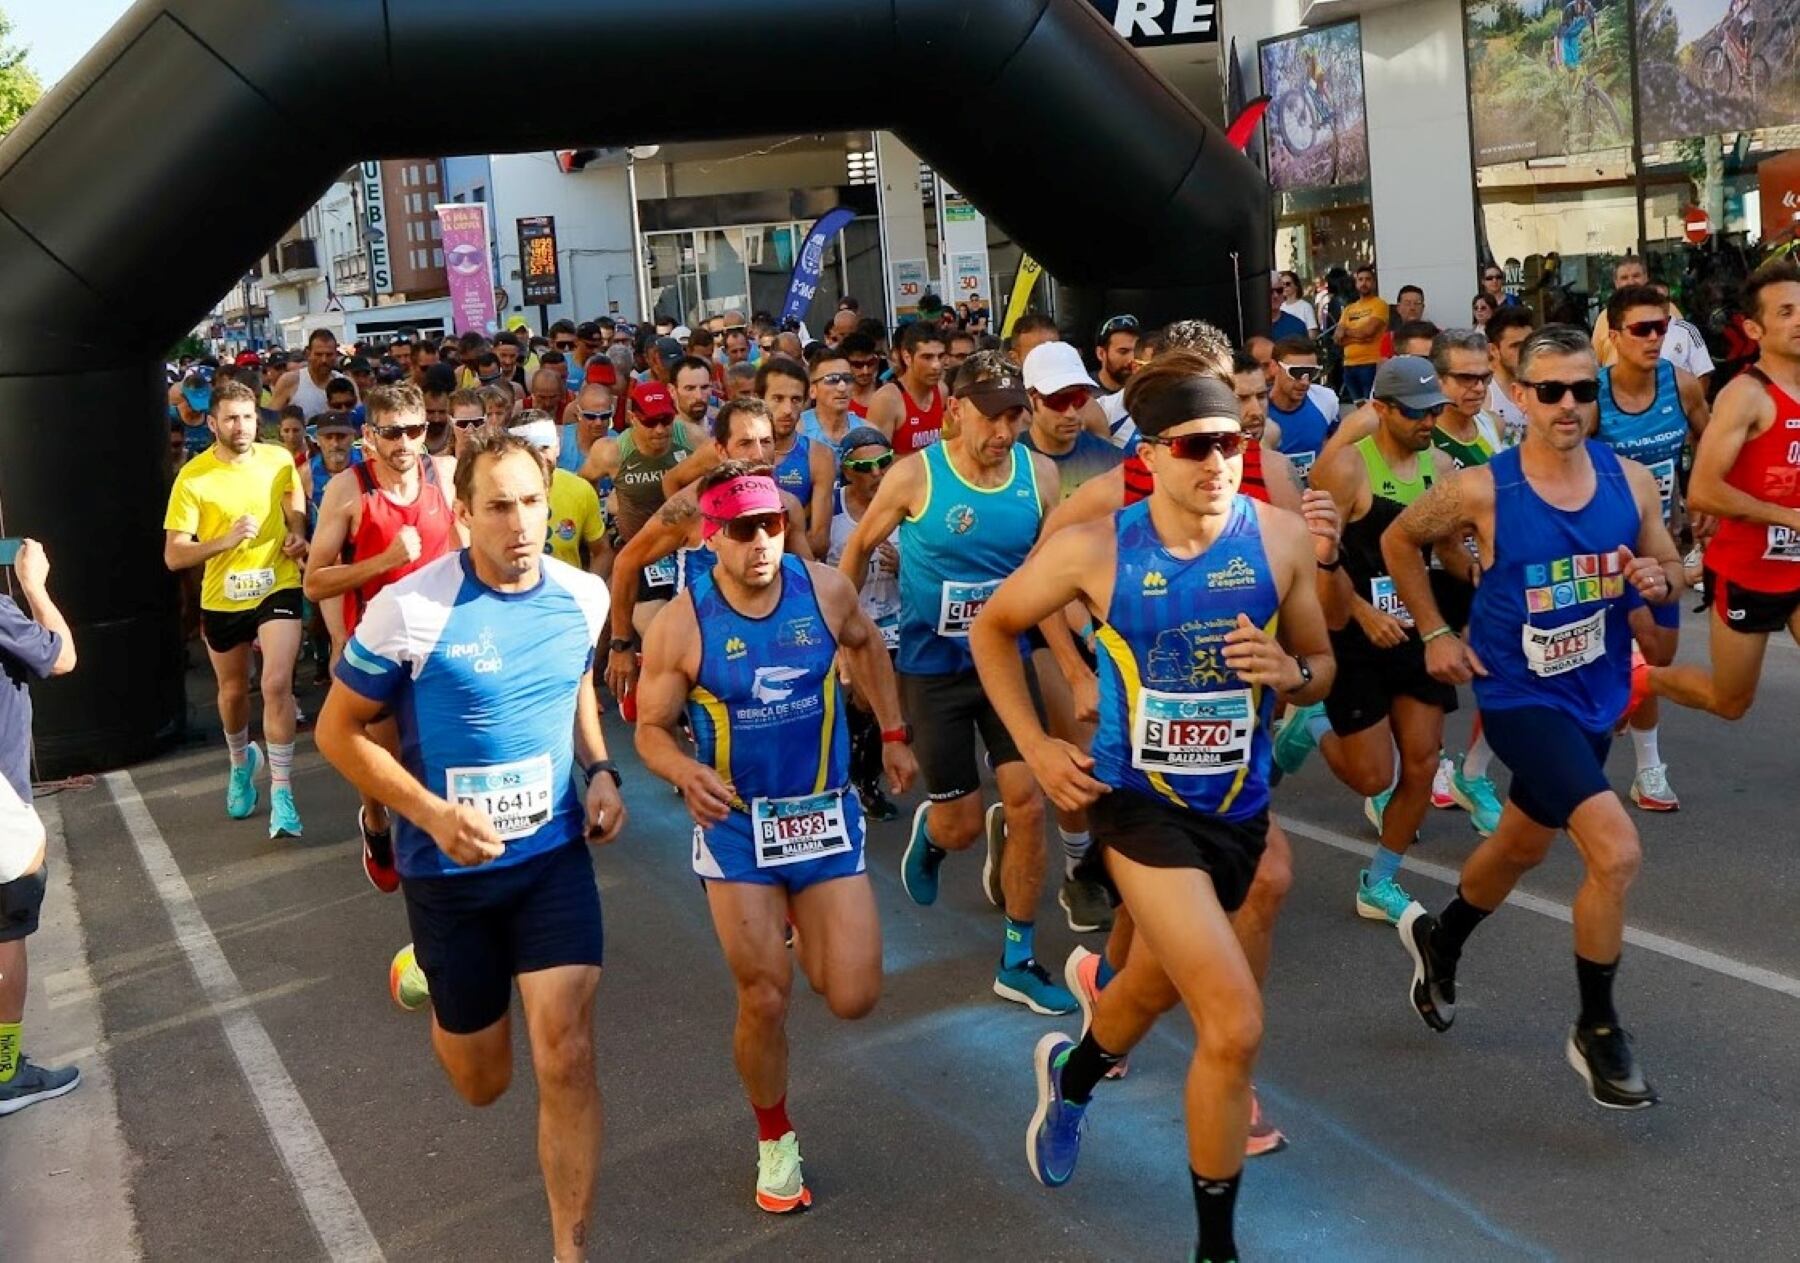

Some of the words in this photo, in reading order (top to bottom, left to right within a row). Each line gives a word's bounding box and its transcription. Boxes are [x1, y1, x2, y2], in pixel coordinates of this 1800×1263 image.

[364, 161, 389, 288] UEBES
[775, 703, 790, 715] DE
[1149, 722, 1161, 741] S
[1171, 724, 1230, 745] 1370
[1167, 752, 1221, 763] BALEARIA
[485, 790, 532, 815] 1641
[764, 822, 774, 839] B
[780, 815, 825, 838] 1393
